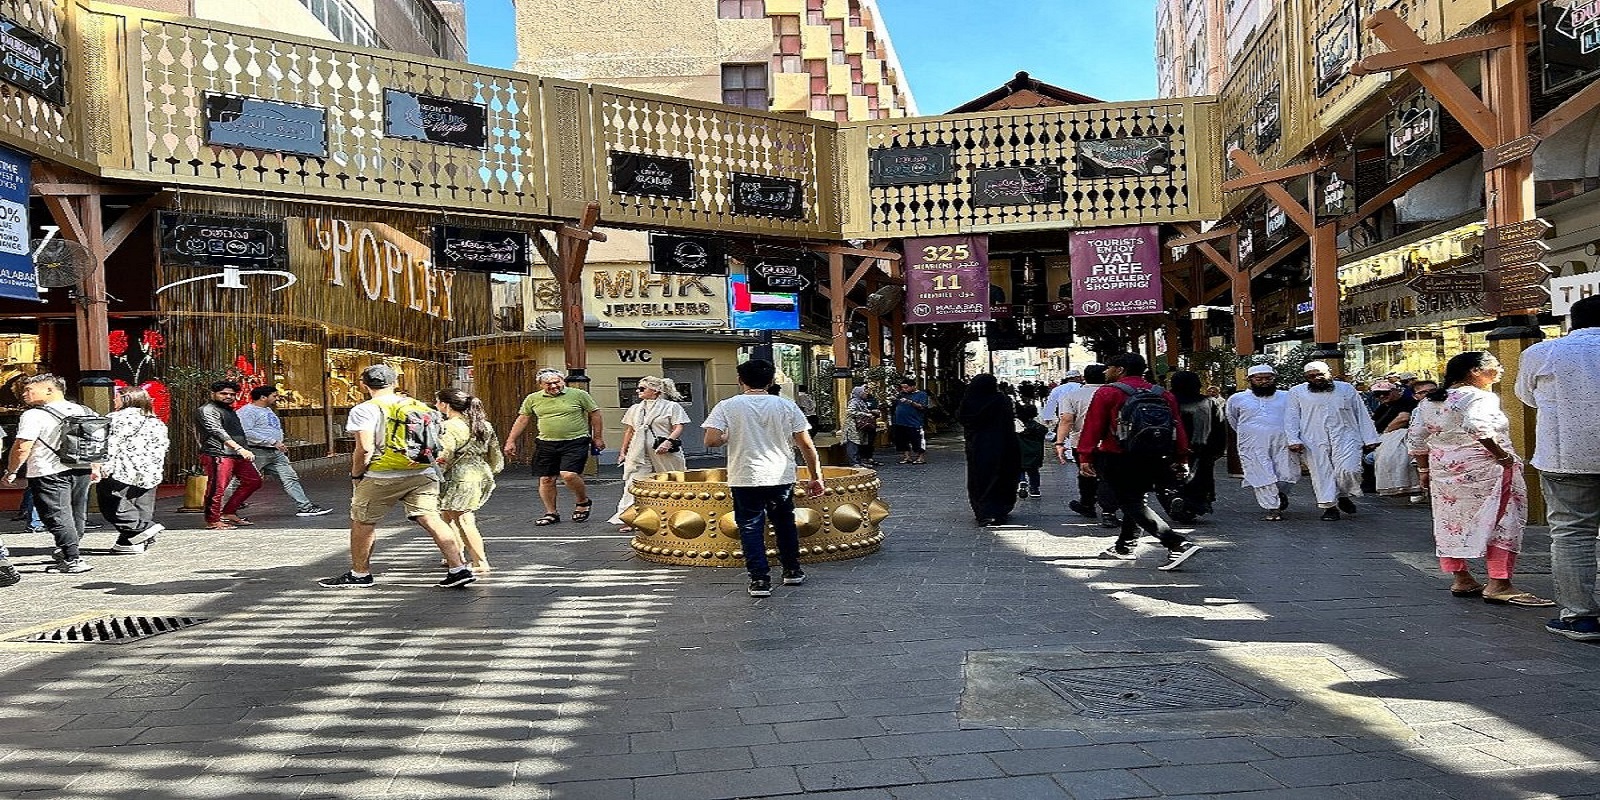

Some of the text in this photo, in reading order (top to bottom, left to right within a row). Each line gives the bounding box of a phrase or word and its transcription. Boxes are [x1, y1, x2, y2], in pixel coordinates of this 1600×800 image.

[1088, 238, 1144, 247] TOURISTS
[922, 244, 970, 262] 325
[1096, 246, 1135, 254] ENJOY
[1097, 253, 1134, 264] VAT
[331, 218, 457, 323] POPLEY
[1092, 263, 1143, 276] FREE
[594, 269, 716, 299] MHK
[931, 274, 962, 291] 11
[1084, 274, 1152, 284] JEWELLERY
[1559, 282, 1600, 303] TH
[602, 302, 711, 318] JEWELLERS
[935, 303, 983, 311] MALABAR
[1106, 299, 1157, 308] MALABAR
[616, 349, 652, 363] WC
